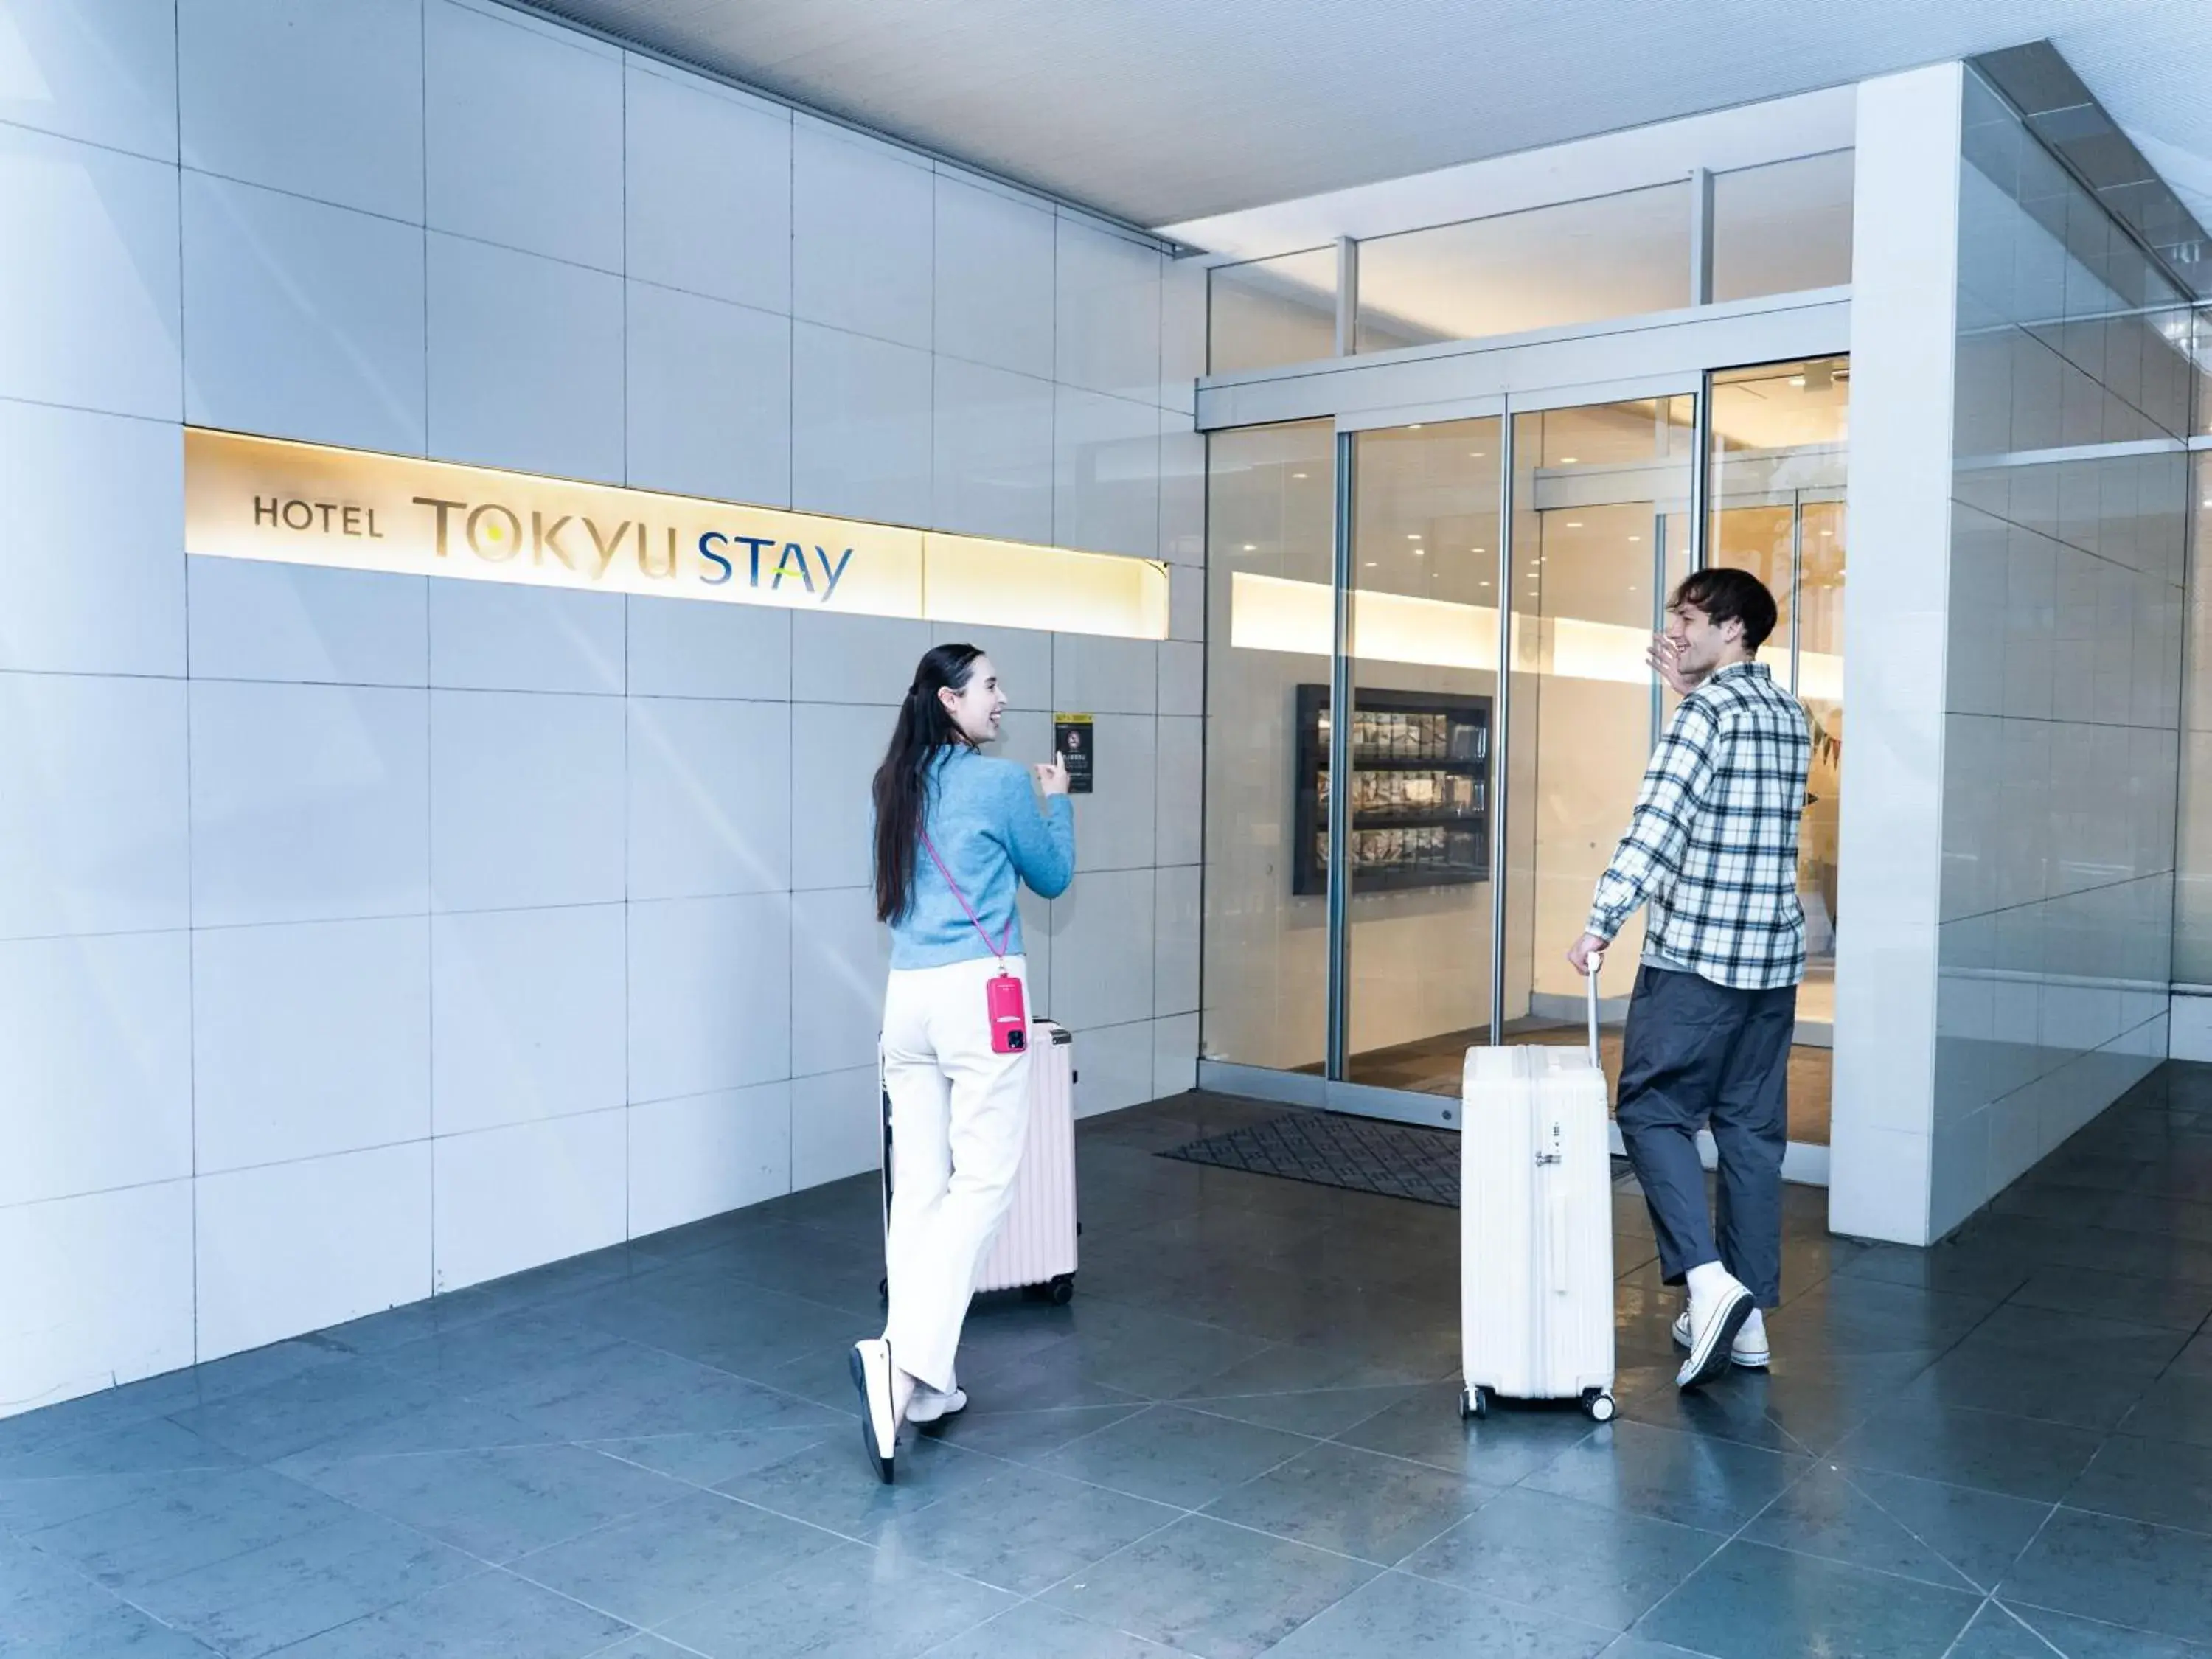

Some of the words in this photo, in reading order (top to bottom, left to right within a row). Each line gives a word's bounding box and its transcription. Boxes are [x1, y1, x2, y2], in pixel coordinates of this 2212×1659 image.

[254, 495, 383, 538] HOTEL
[412, 496, 677, 580] TOKYU
[698, 531, 854, 603] STAY
